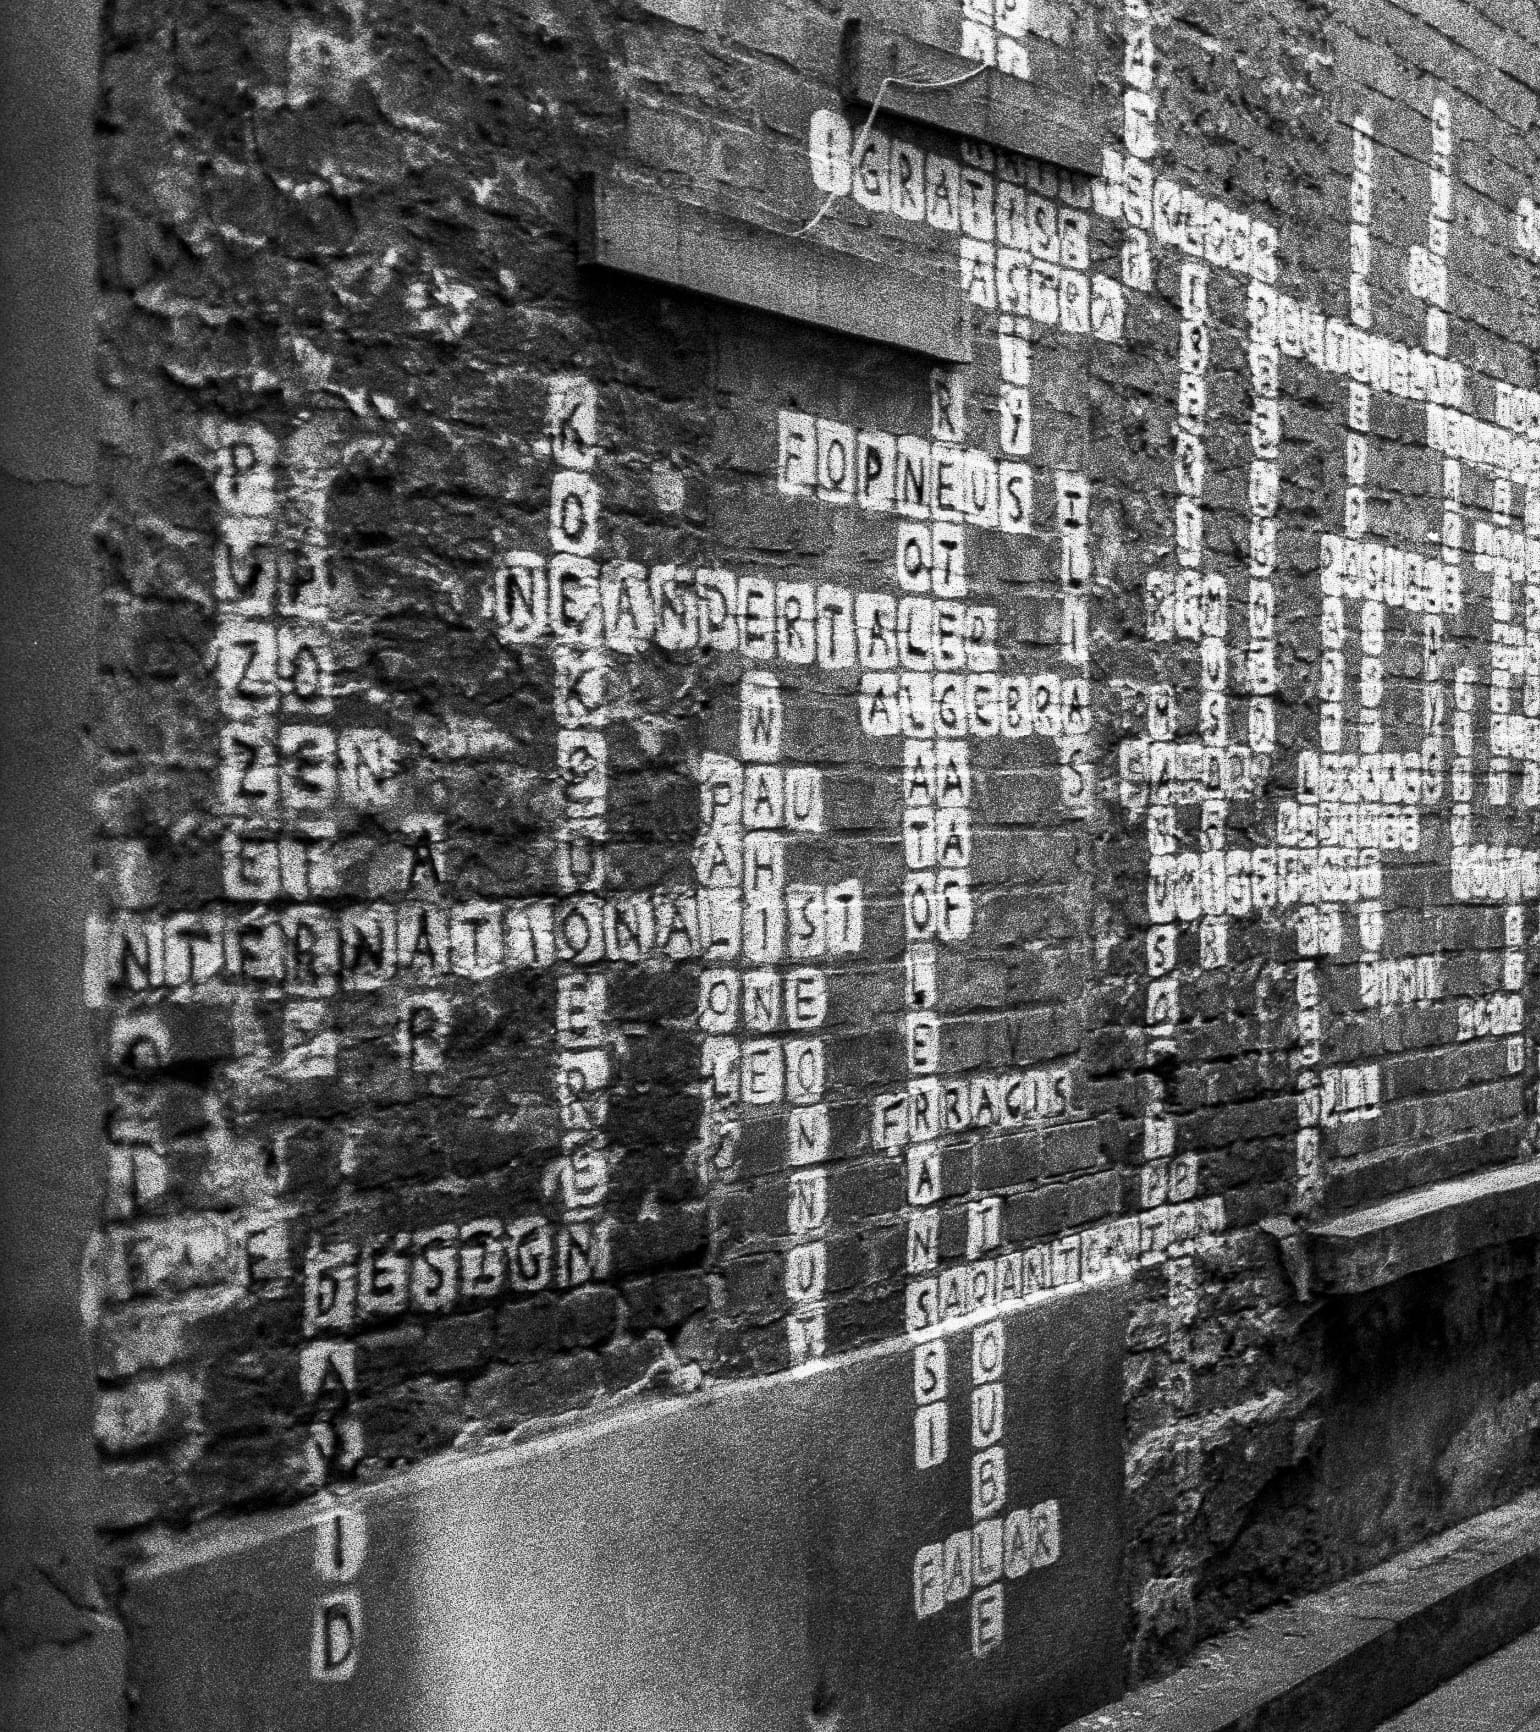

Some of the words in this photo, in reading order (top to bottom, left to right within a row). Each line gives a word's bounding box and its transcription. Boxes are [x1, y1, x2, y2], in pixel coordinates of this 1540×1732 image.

[780, 412, 1031, 532] FOPNEUS
[863, 674, 1090, 736] ALGEBRA
[82, 880, 861, 1006] NTERNATIONALIST
[307, 1222, 612, 1335] DESIGN
[914, 1500, 1061, 1620] FALAR
